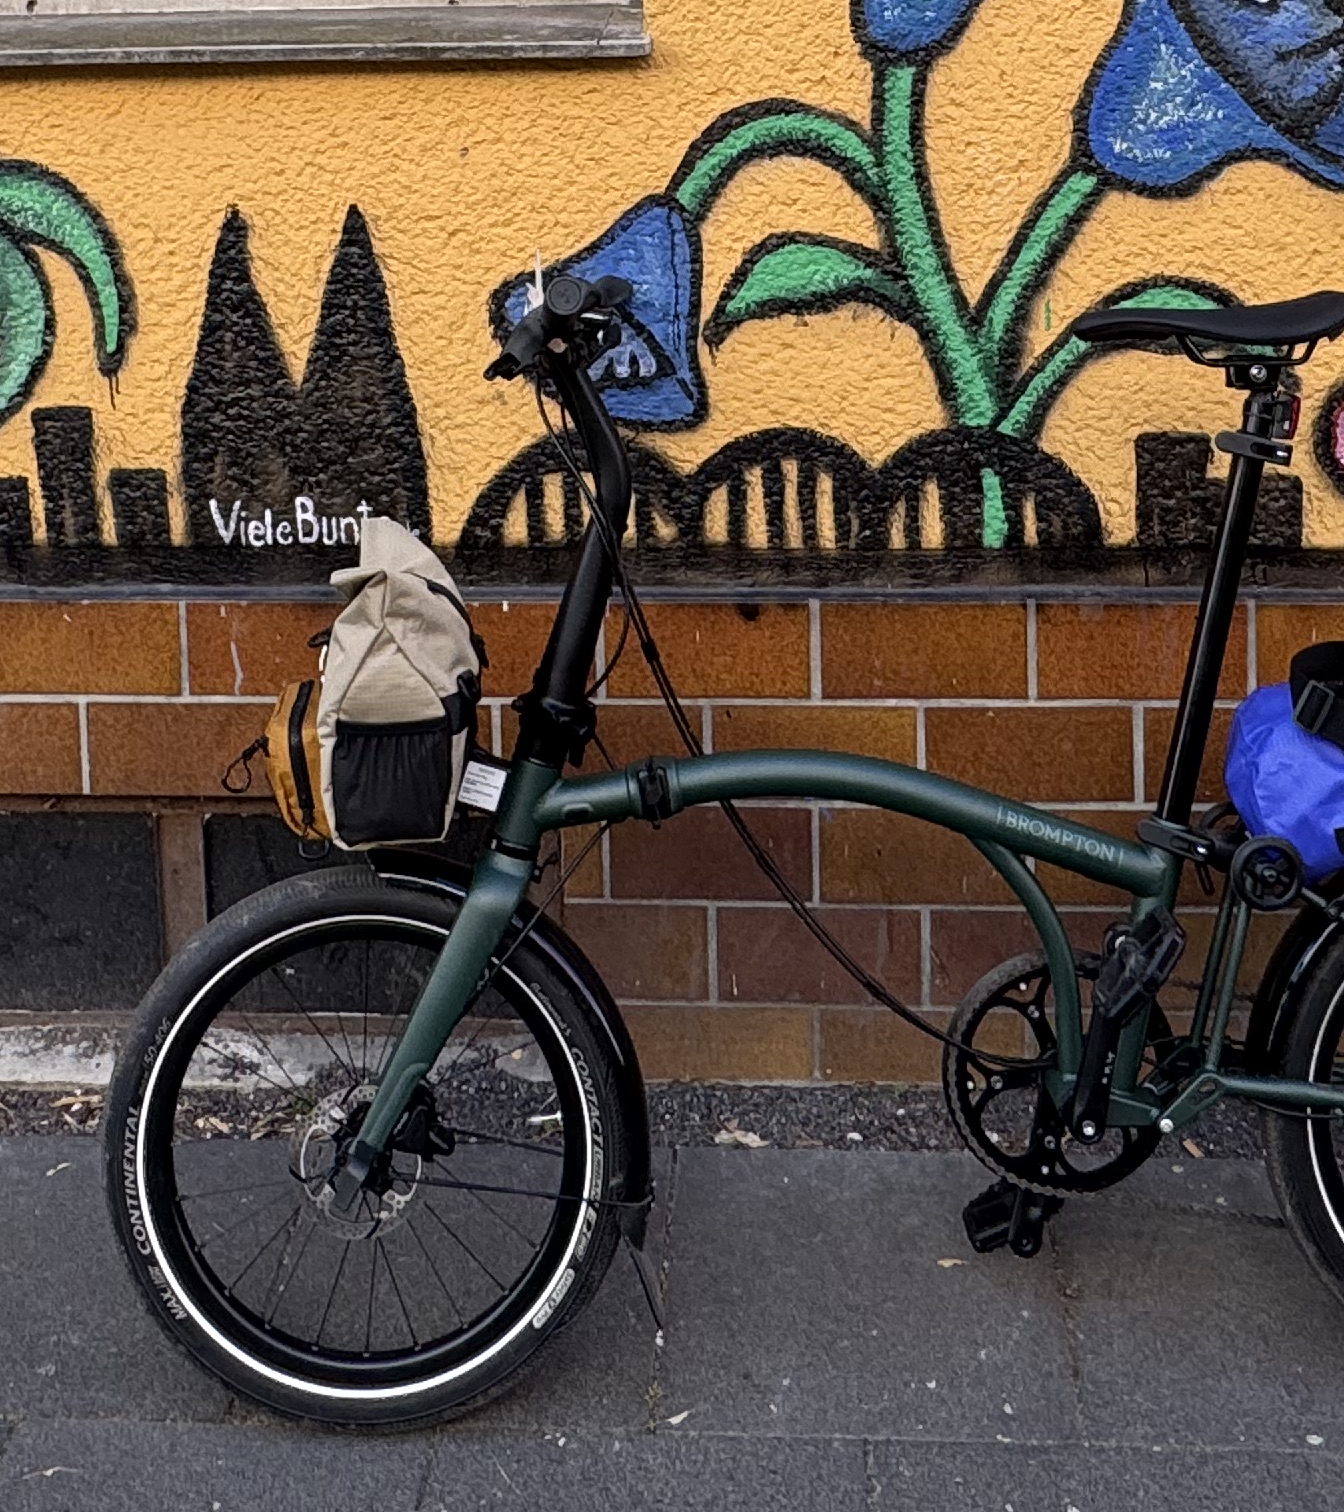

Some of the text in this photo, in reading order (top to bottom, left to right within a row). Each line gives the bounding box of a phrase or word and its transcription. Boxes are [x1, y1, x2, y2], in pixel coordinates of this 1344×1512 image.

[209, 498, 293, 547] Viele
[1006, 810, 1116, 862] BROMPTON
[571, 1046, 604, 1149] CONTACT
[123, 1106, 152, 1256] CONTINENTAL
